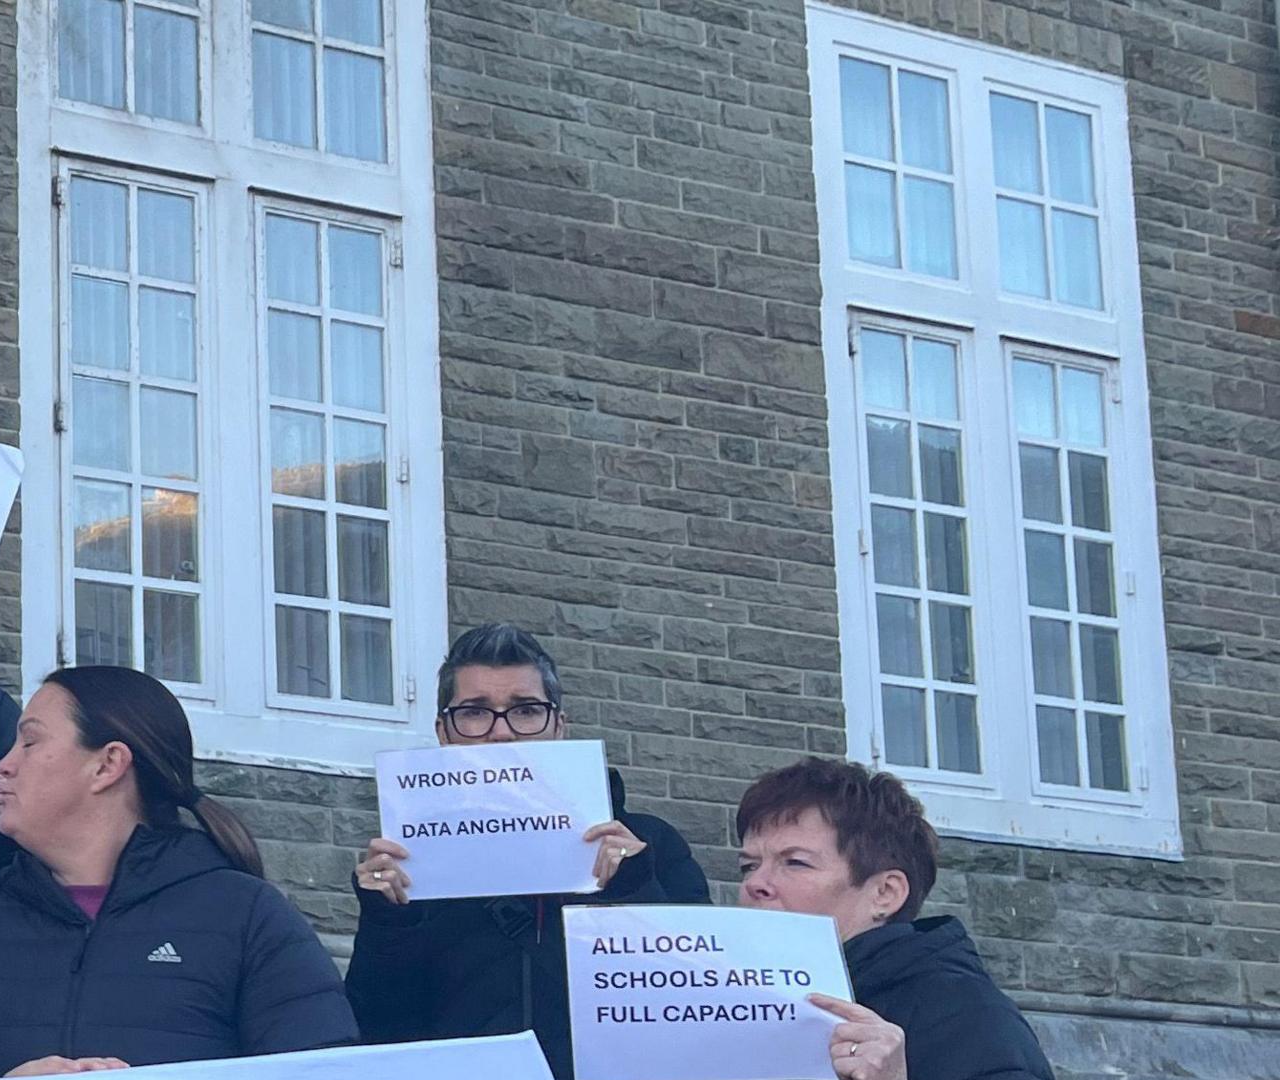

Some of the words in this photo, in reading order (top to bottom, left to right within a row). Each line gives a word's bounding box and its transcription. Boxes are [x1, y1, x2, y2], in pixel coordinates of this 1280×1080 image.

[396, 770, 477, 790] WRONG
[483, 767, 534, 784] DATA
[402, 821, 451, 839] DATA
[456, 814, 572, 836] ANGHYWIR
[592, 937, 635, 955] ALL
[642, 935, 724, 953] LOCAL
[594, 970, 718, 989] SCHOOLS
[725, 969, 775, 987] ARE
[779, 969, 812, 987] TO
[597, 1006, 657, 1023] FULL
[663, 1003, 797, 1023] CAPACITY!
